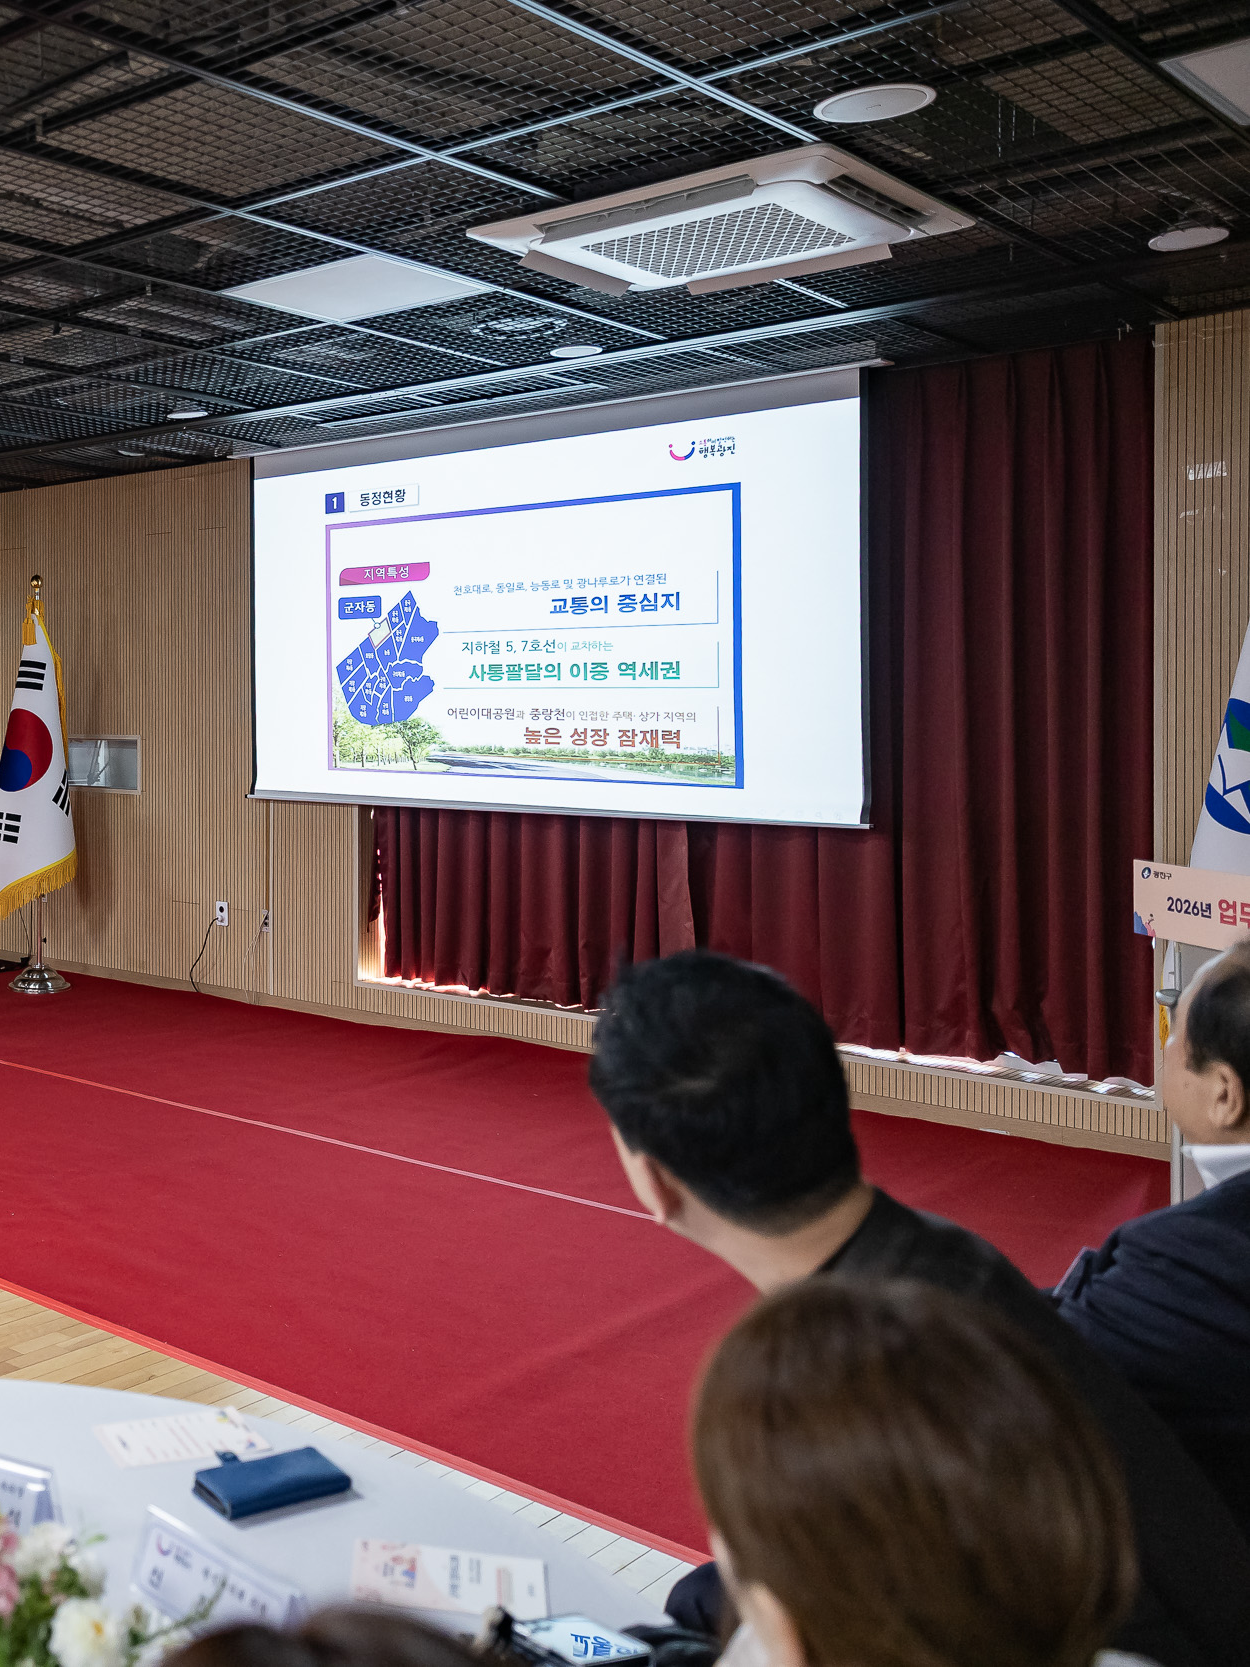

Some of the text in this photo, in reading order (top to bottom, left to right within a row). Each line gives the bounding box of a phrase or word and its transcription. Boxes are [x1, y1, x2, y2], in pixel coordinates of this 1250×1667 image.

[699, 444, 735, 458] 행복광진
[331, 488, 406, 510] 1 동정현황
[363, 565, 410, 581] 지역특성
[453, 573, 667, 595] 천호대로, 동일로, 능동로 및 광나루로가 연결된
[344, 600, 376, 614] 군자동
[549, 591, 681, 615] 교통의 중심지
[461, 639, 614, 655] 지하철 5, 7호선이 교차하는
[468, 660, 681, 682] 사통팔달의 이중 역세권
[447, 707, 525, 721] 어린이대공원과
[529, 707, 576, 721] 중랑천이
[578, 709, 609, 722] 인접한
[638, 711, 660, 722] 상가
[663, 711, 696, 723] 지역의
[523, 726, 681, 749] 높은 성장 잠재력
[1153, 870, 1172, 880] 광진구
[1166, 896, 1212, 919] 2026년
